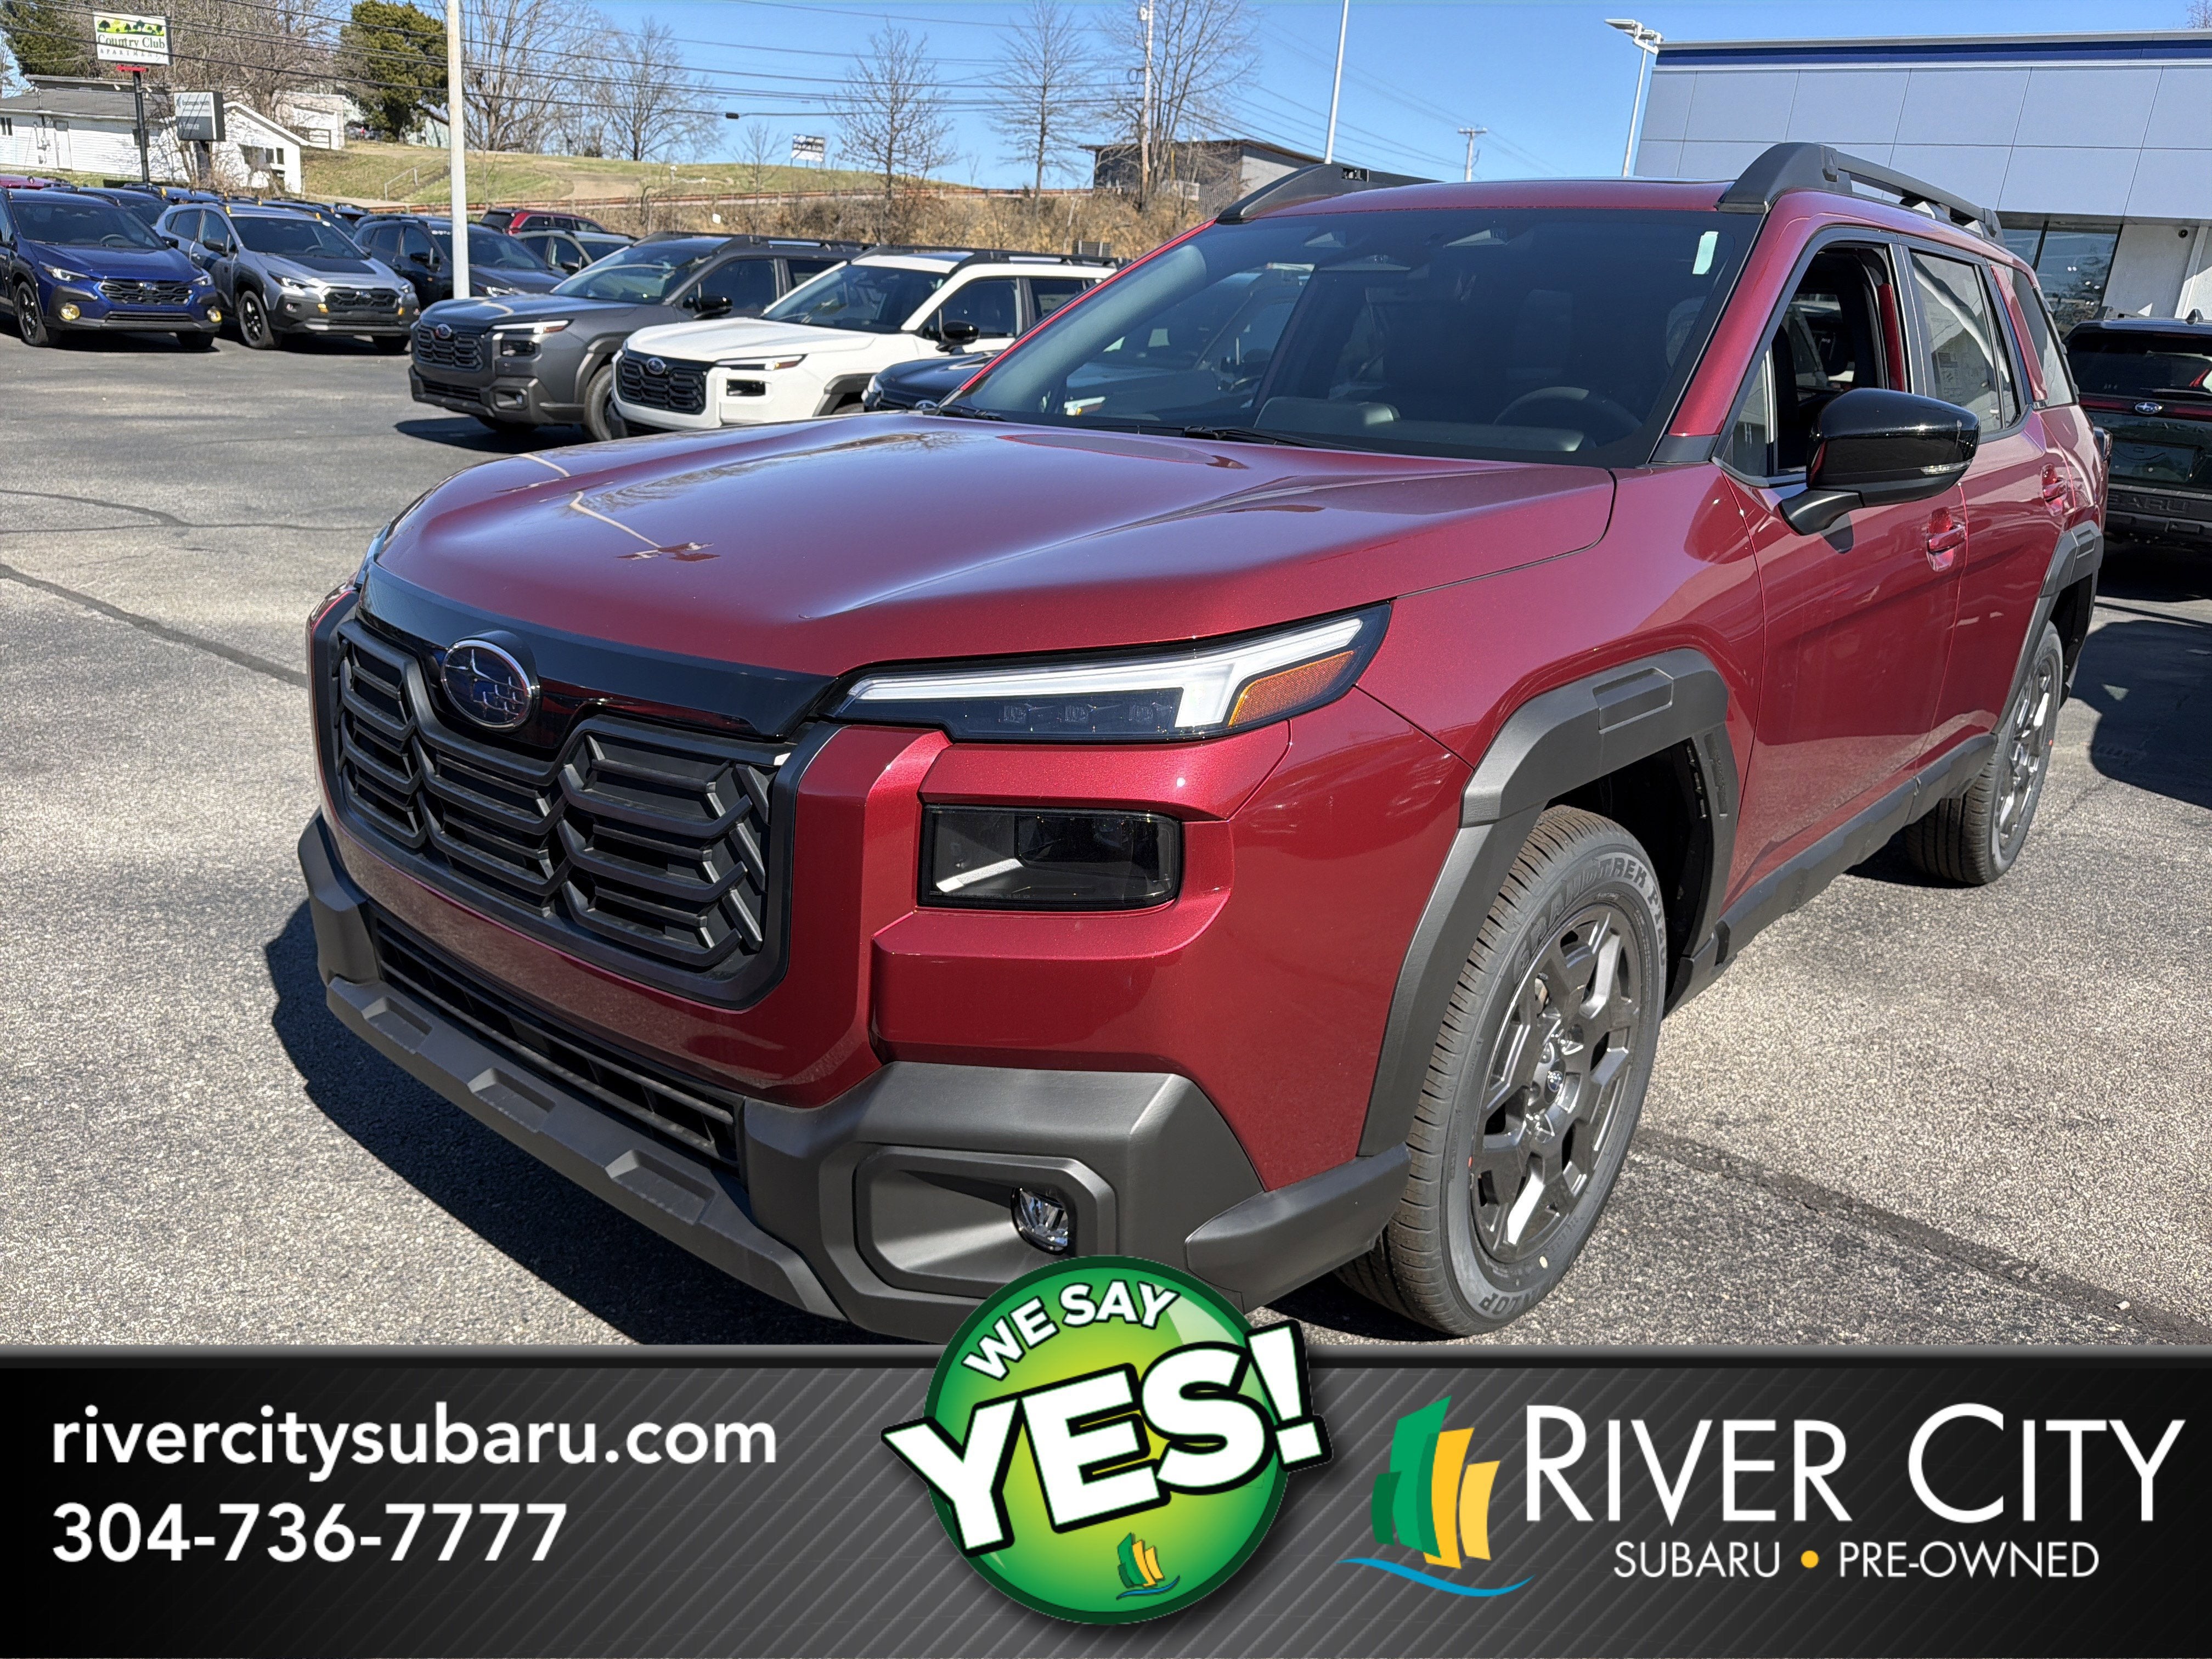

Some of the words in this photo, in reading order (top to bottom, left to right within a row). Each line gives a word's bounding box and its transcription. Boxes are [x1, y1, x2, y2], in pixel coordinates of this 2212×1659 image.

[98, 34, 139, 47] Country
[142, 37, 165, 49] Club
[100, 48, 165, 58] APARTMEN
